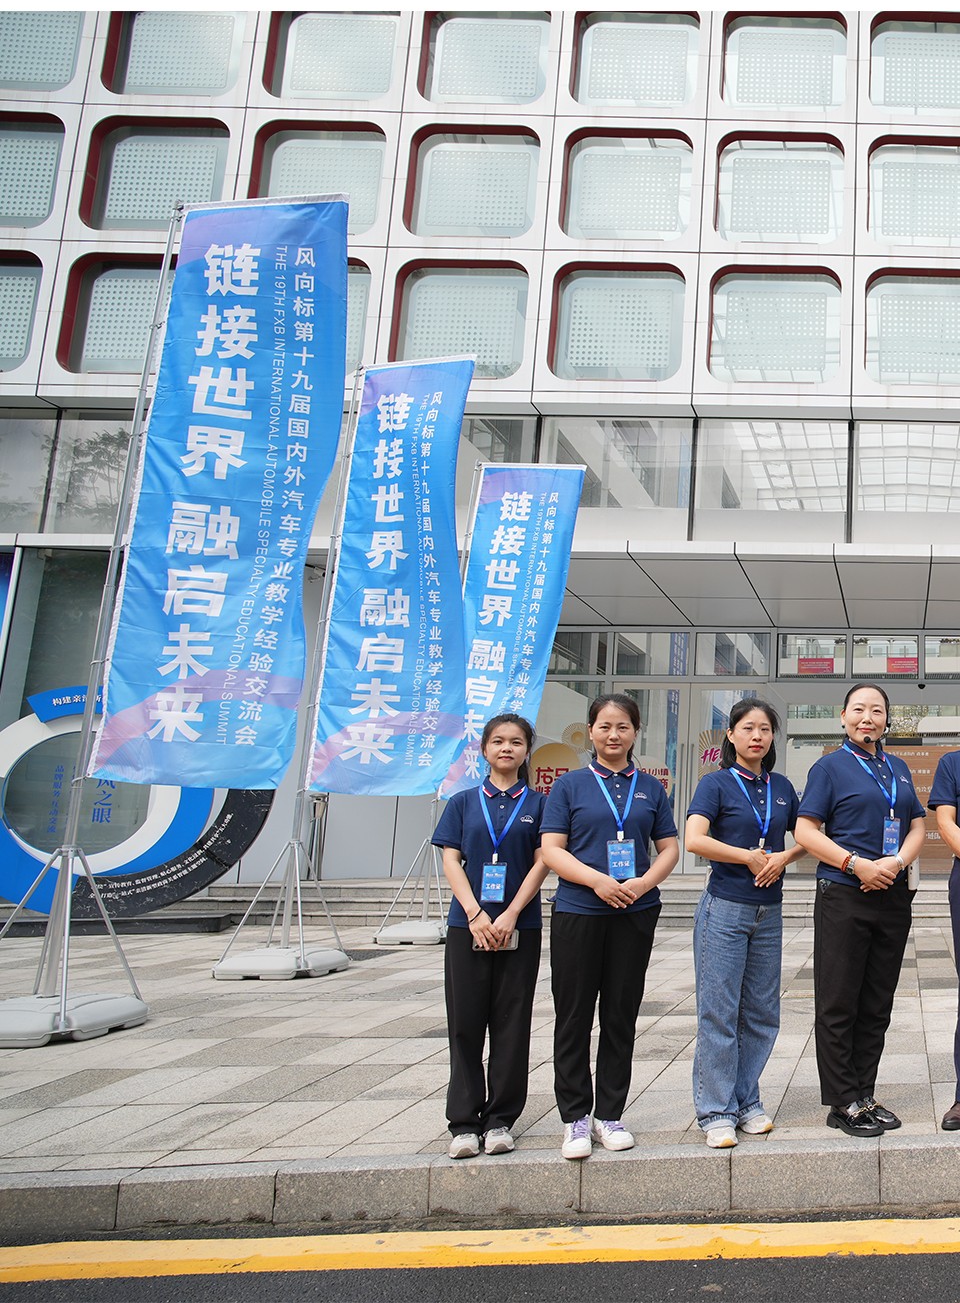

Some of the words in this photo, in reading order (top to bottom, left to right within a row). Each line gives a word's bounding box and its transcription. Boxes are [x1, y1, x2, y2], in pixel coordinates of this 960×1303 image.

[274, 274, 287, 306] 19TH
[275, 245, 288, 270] THE
[274, 308, 287, 334] FXB
[180, 242, 262, 480] 链接世界
[268, 336, 287, 440] INTERNATIONAL
[412, 412, 425, 434] 19TH
[418, 393, 431, 411] THE
[364, 391, 415, 571] 链接世界
[410, 435, 418, 454] FXB
[234, 247, 316, 746] 风向标第十九届国内外汽车专业教学经验交流会
[259, 445, 279, 528] AUTOMOBILE
[410, 457, 424, 535] INTERNATIONAL
[247, 530, 271, 599] SPECIALTY
[417, 390, 445, 768] 风向标第十九届国内外汽车专业教学经验交流会
[478, 490, 534, 627] 链接世界
[521, 542, 538, 603] INTERNATIONAL
[147, 501, 240, 743] 融启未来
[222, 598, 255, 696] EDUCATIONAL
[338, 587, 411, 765] 融启未来
[409, 658, 425, 727] EDUCATIONAL
[460, 639, 507, 780] 融启未来
[216, 691, 233, 745] SUMMIT
[403, 727, 417, 767] SUMMIT
[612, 860, 630, 868] 工作证
